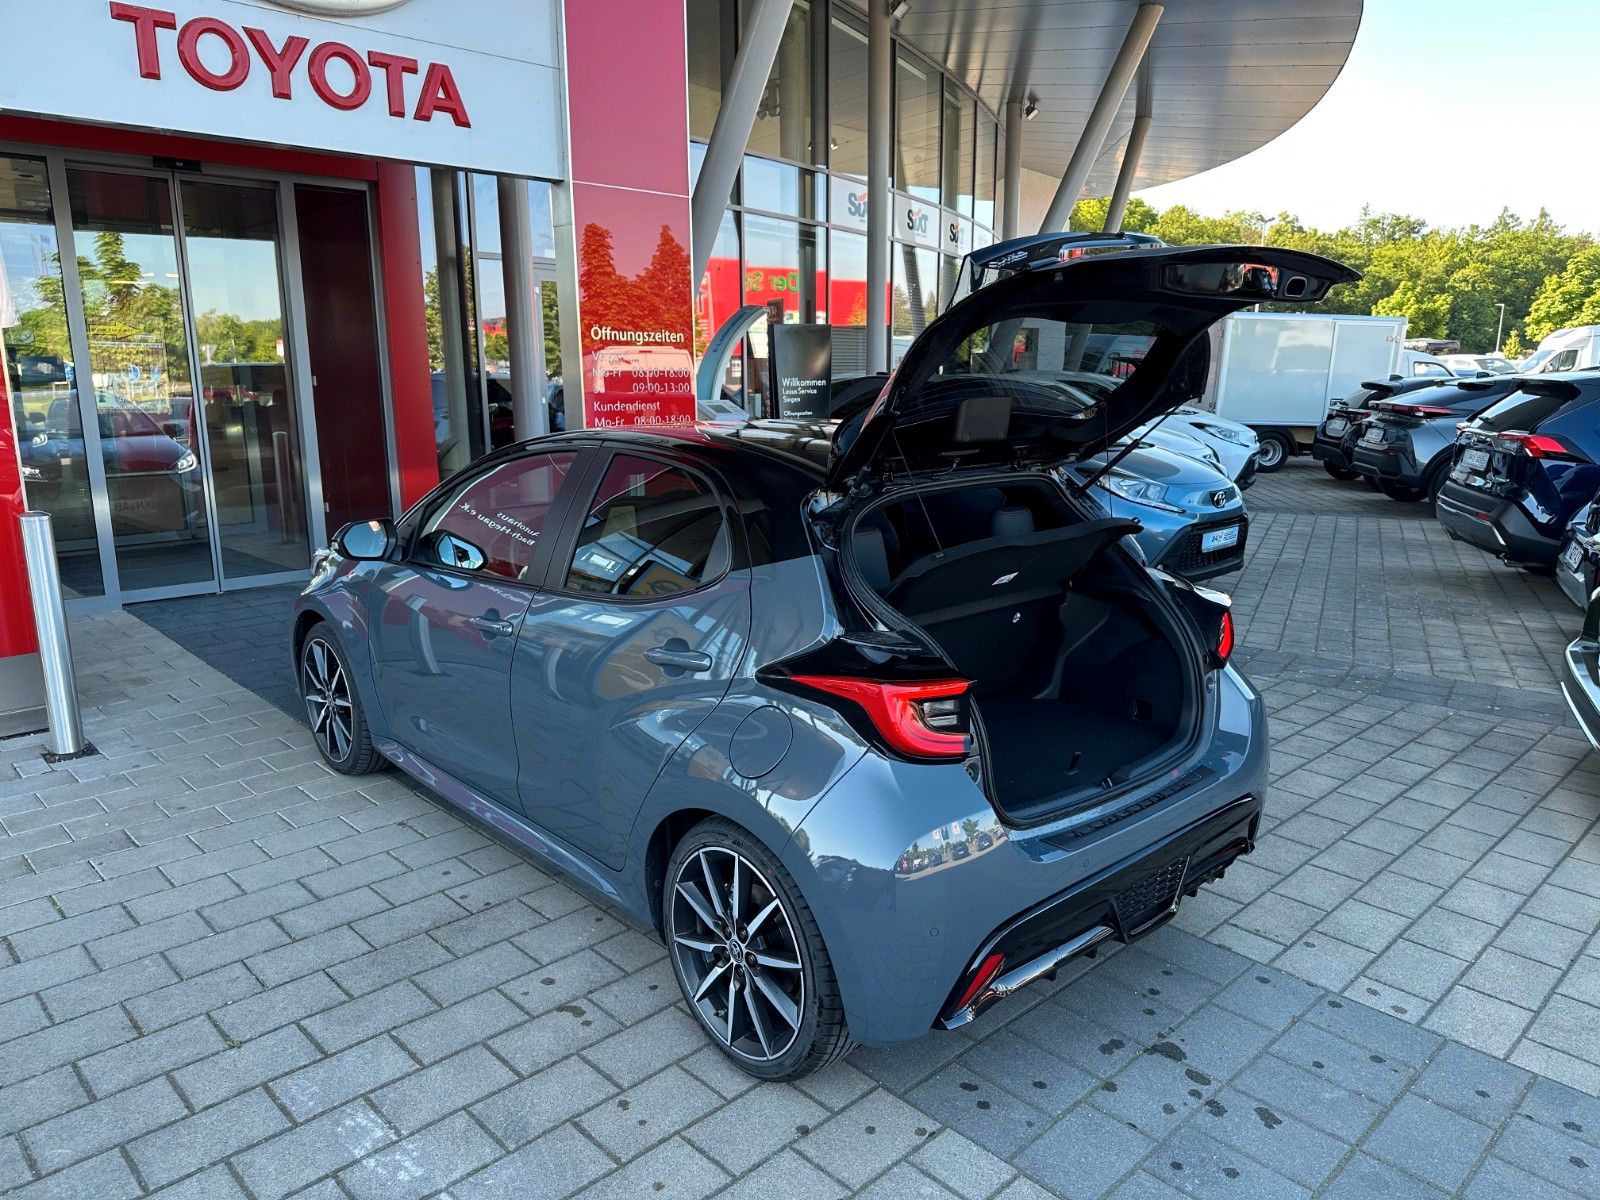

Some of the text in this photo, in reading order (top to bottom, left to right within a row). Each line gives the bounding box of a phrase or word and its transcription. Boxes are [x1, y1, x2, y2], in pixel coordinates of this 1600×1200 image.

[110, 1, 471, 128] TOYOTA
[590, 324, 685, 345] Öffnungszeiten
[632, 366, 690, 378] 08:00-18:00
[632, 382, 690, 394] 09:00-13:00
[781, 377, 827, 387] Willkommen
[782, 387, 818, 395] Lexus Service
[782, 395, 801, 404] Singen
[593, 400, 661, 412] Kundendienst
[594, 414, 691, 428] Mo-Fr 08:00-18:00
